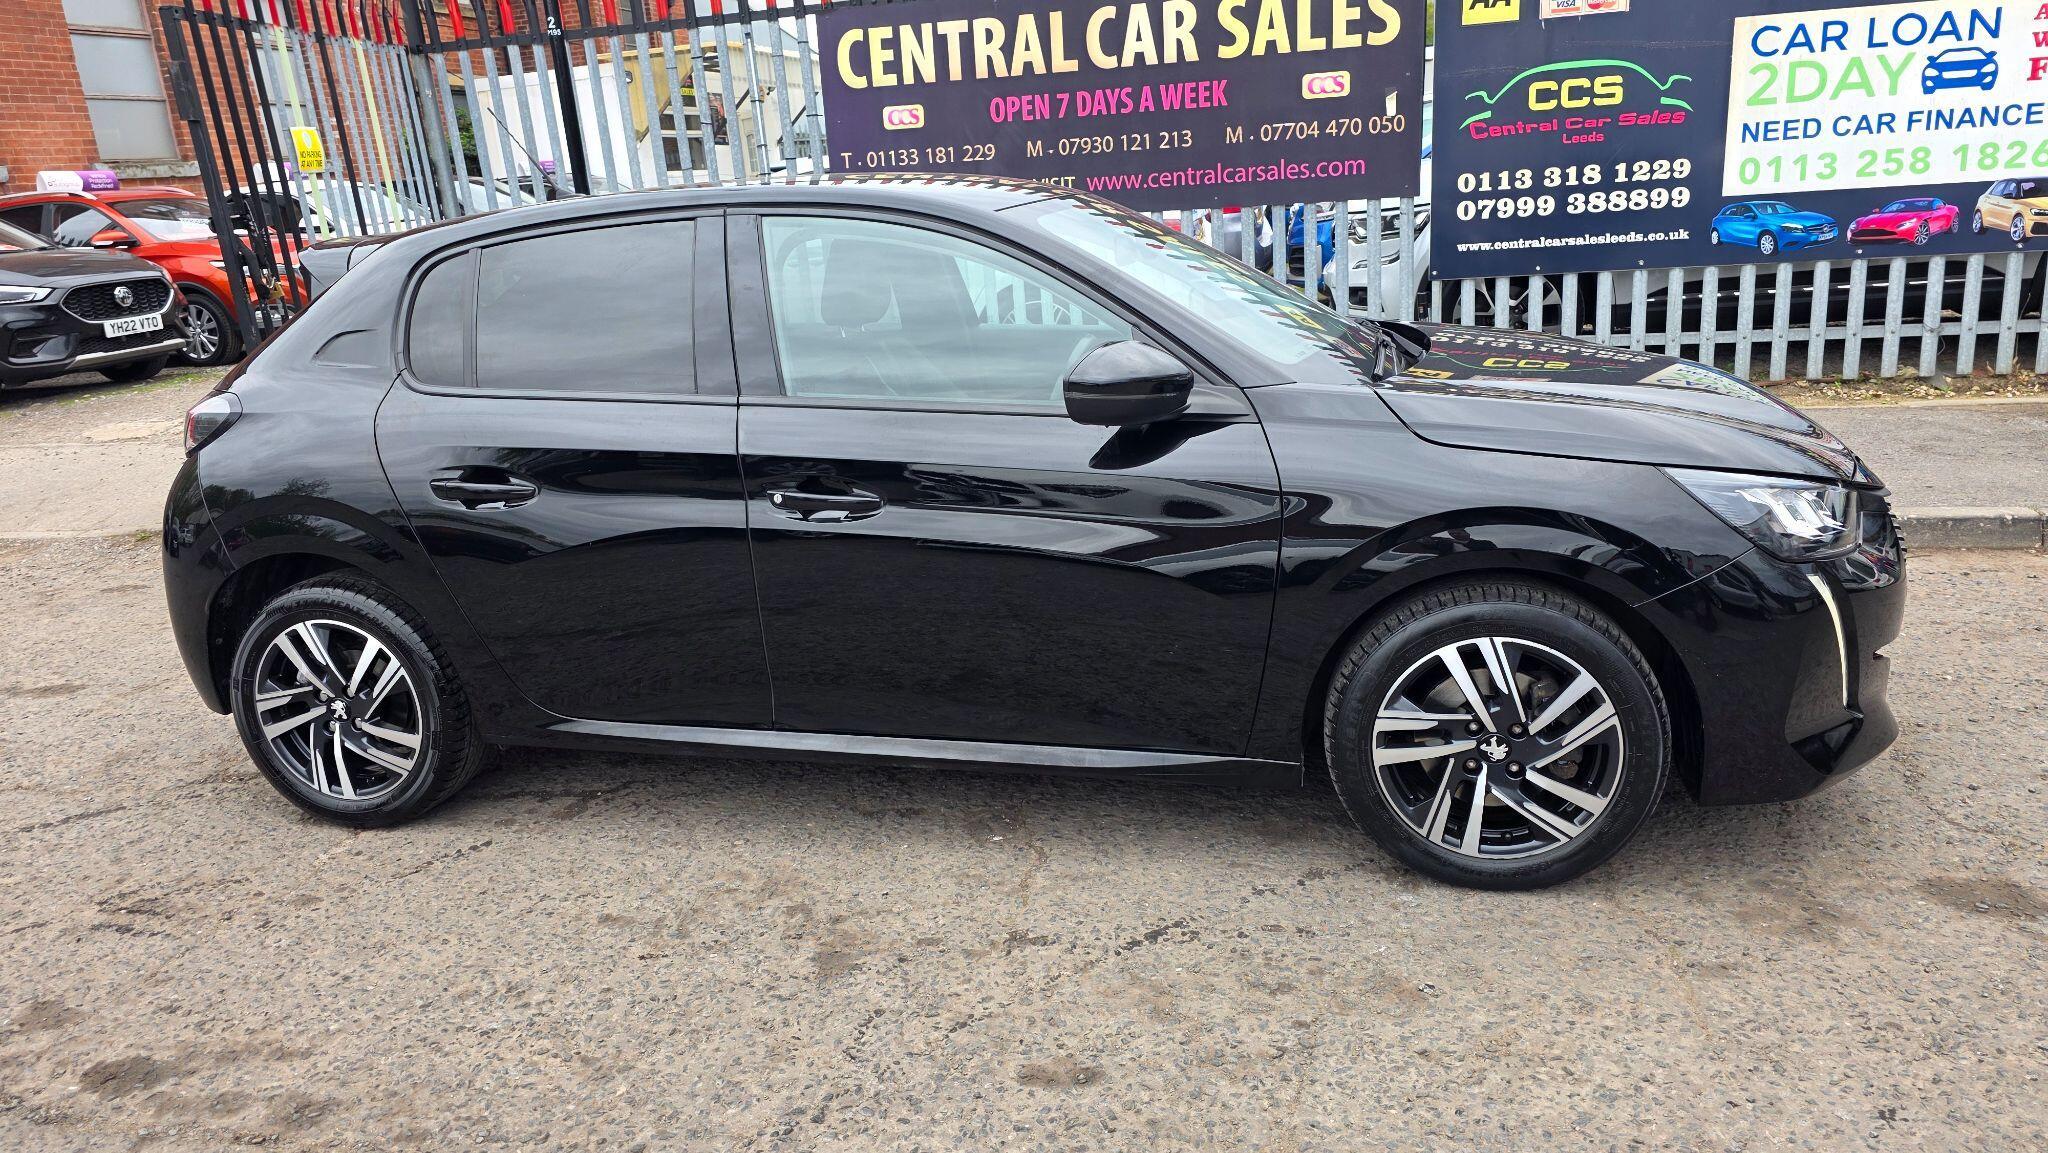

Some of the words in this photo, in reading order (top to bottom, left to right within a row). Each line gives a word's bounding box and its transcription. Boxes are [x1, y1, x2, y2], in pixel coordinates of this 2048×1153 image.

[547, 16, 556, 28] 2
[1751, 20, 1849, 57] CAR
[1867, 6, 2003, 48] LOAN
[837, 11, 1079, 89] CENTRAL
[1086, 0, 1199, 69] CAR
[1217, 0, 1401, 59] SALES
[1307, 75, 1345, 94] CCS
[1528, 74, 1624, 111] CCS
[1746, 51, 1918, 106] 2DAY
[888, 108, 920, 126] CCS
[989, 93, 1050, 123] OPEN
[1056, 93, 1070, 118] 7
[1076, 85, 1134, 117] DAYS
[1139, 85, 1155, 113] A
[1160, 80, 1228, 111] WEEK
[1260, 120, 1320, 142] 07704
[1325, 117, 1363, 137] 470
[1368, 114, 1406, 134] 050
[1469, 118, 1558, 140] Central
[1565, 117, 1612, 129] Car
[1618, 109, 1687, 126] Sales
[1562, 131, 1605, 144] Leeds
[1741, 117, 1822, 143] NEED
[1832, 112, 1897, 137] CAR
[1906, 102, 2046, 132] FINANCE
[866, 148, 919, 168] 01133
[926, 146, 955, 164] 181
[962, 143, 996, 162] 229
[1058, 135, 1114, 156] 07930
[1120, 132, 1150, 151] 121
[1159, 129, 1193, 149] 213
[1086, 158, 1366, 192] www.centralcarsales.com
[1457, 168, 1533, 193] 0113
[1543, 164, 1602, 187] 318
[1614, 158, 1692, 183] 1229
[1738, 152, 1838, 185] 0113
[1855, 146, 1932, 178] 258
[1952, 139, 2048, 172] 1826
[1456, 194, 1556, 221] 07999
[1566, 186, 1691, 214] 388899
[1456, 228, 1690, 252] www.centralcarsalesleeds.co.uk
[110, 320, 138, 334] YH22
[139, 317, 159, 329] VTO
